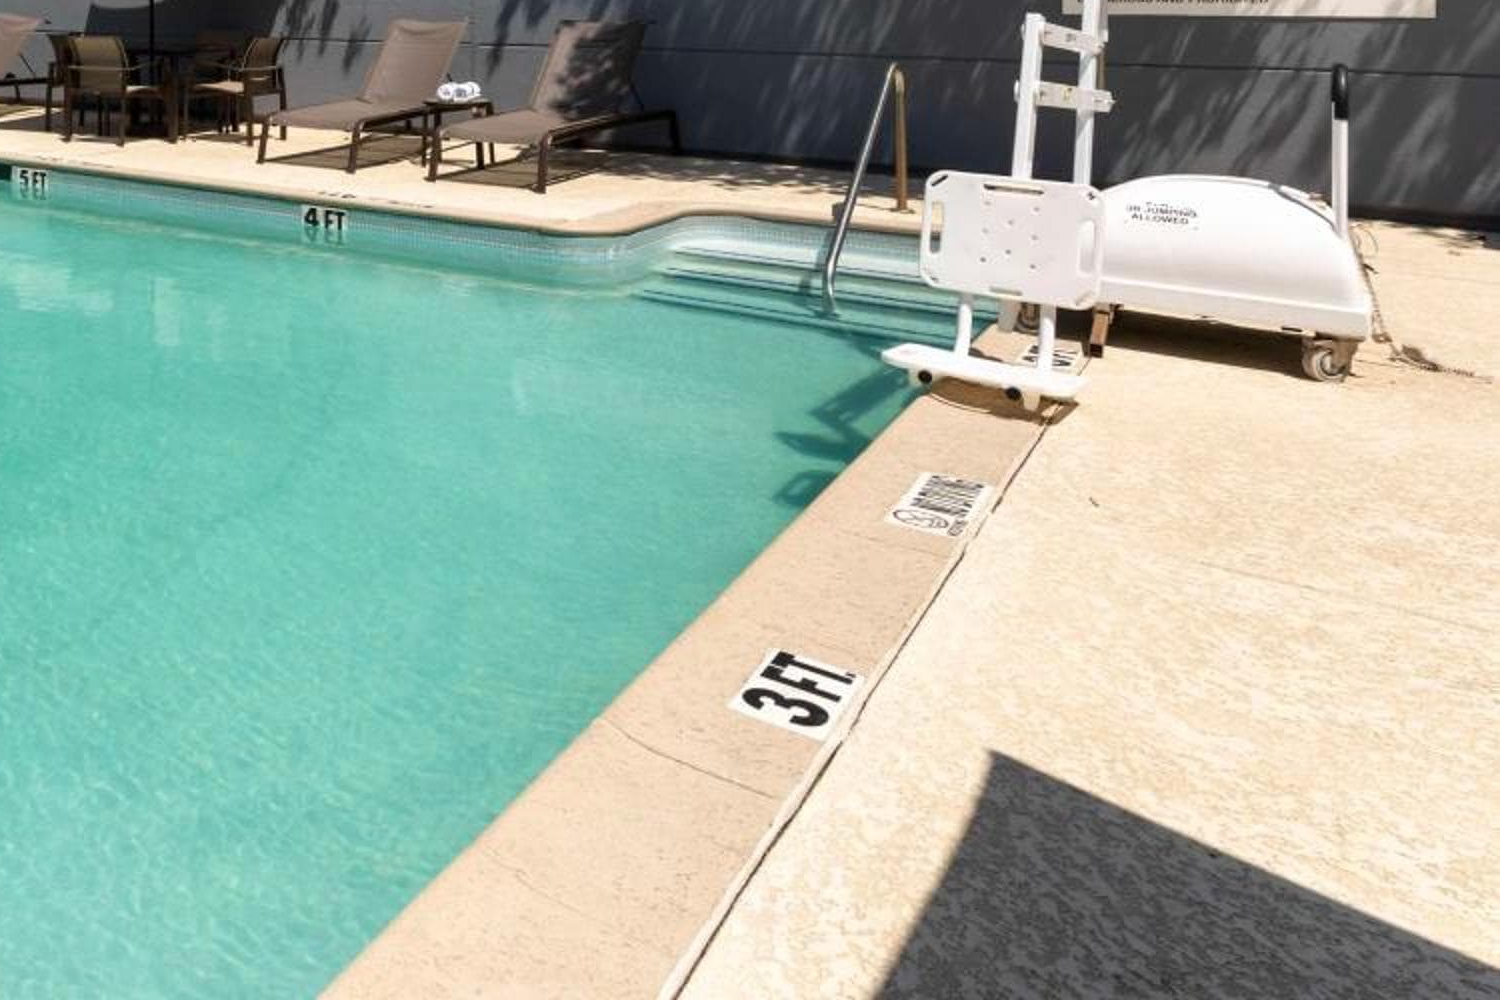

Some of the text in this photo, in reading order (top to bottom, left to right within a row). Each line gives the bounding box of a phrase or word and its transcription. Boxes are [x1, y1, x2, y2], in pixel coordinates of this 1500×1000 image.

[304, 207, 346, 230] 4 FT
[1131, 212, 1189, 225] ALLOWED
